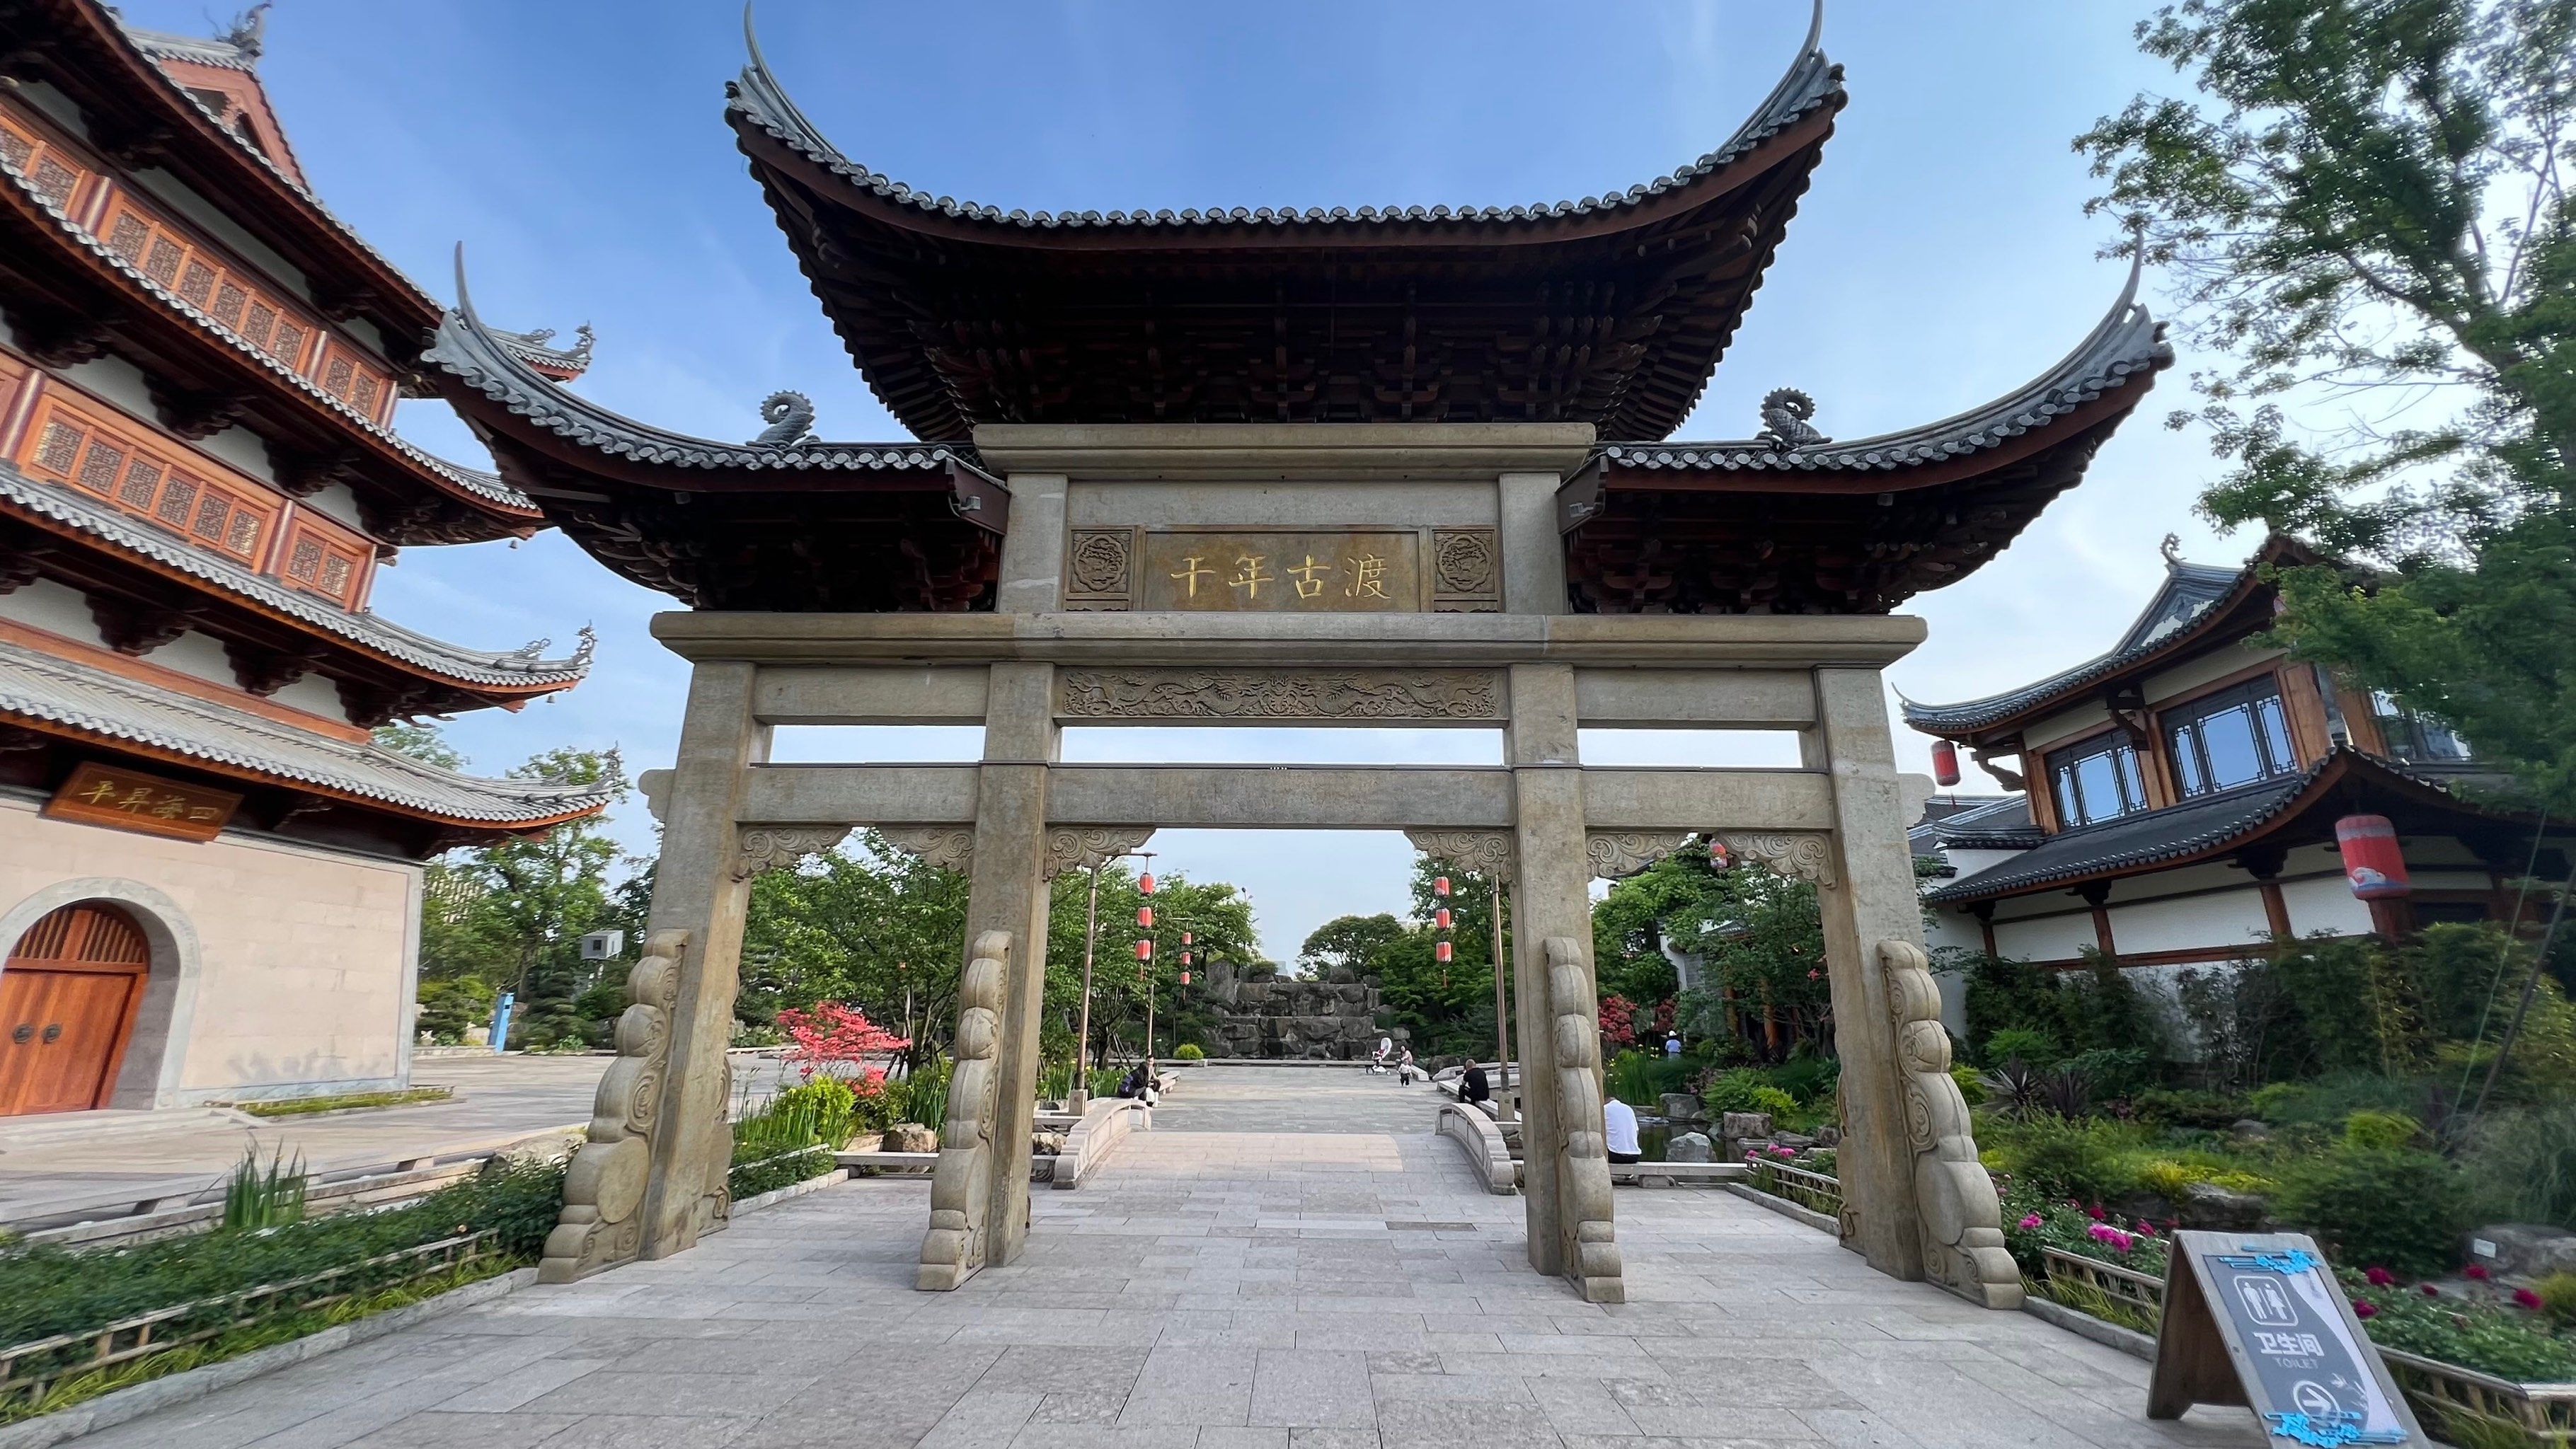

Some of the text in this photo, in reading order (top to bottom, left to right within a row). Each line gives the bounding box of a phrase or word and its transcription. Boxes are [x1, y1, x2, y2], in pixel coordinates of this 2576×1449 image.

[1170, 553, 1392, 600] 千年古渡
[2253, 1332, 2325, 1357] 卫生间
[2273, 1357, 2319, 1370] TOILET
